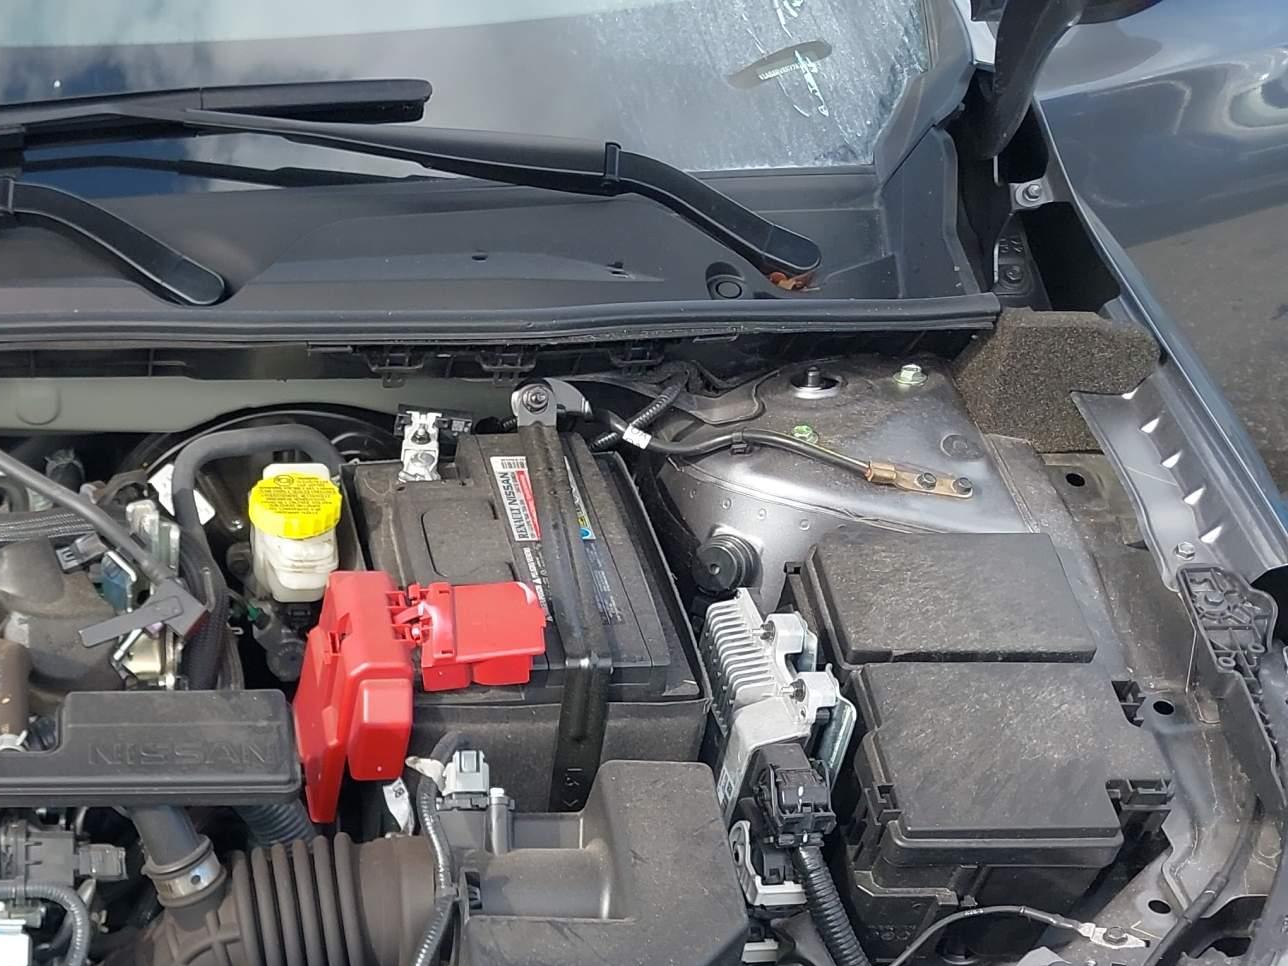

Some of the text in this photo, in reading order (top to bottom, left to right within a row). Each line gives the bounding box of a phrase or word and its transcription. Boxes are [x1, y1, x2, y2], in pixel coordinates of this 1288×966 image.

[497, 471, 519, 506] NISSAN
[509, 505, 530, 540] RENAULT
[85, 740, 276, 766] NISSAN
